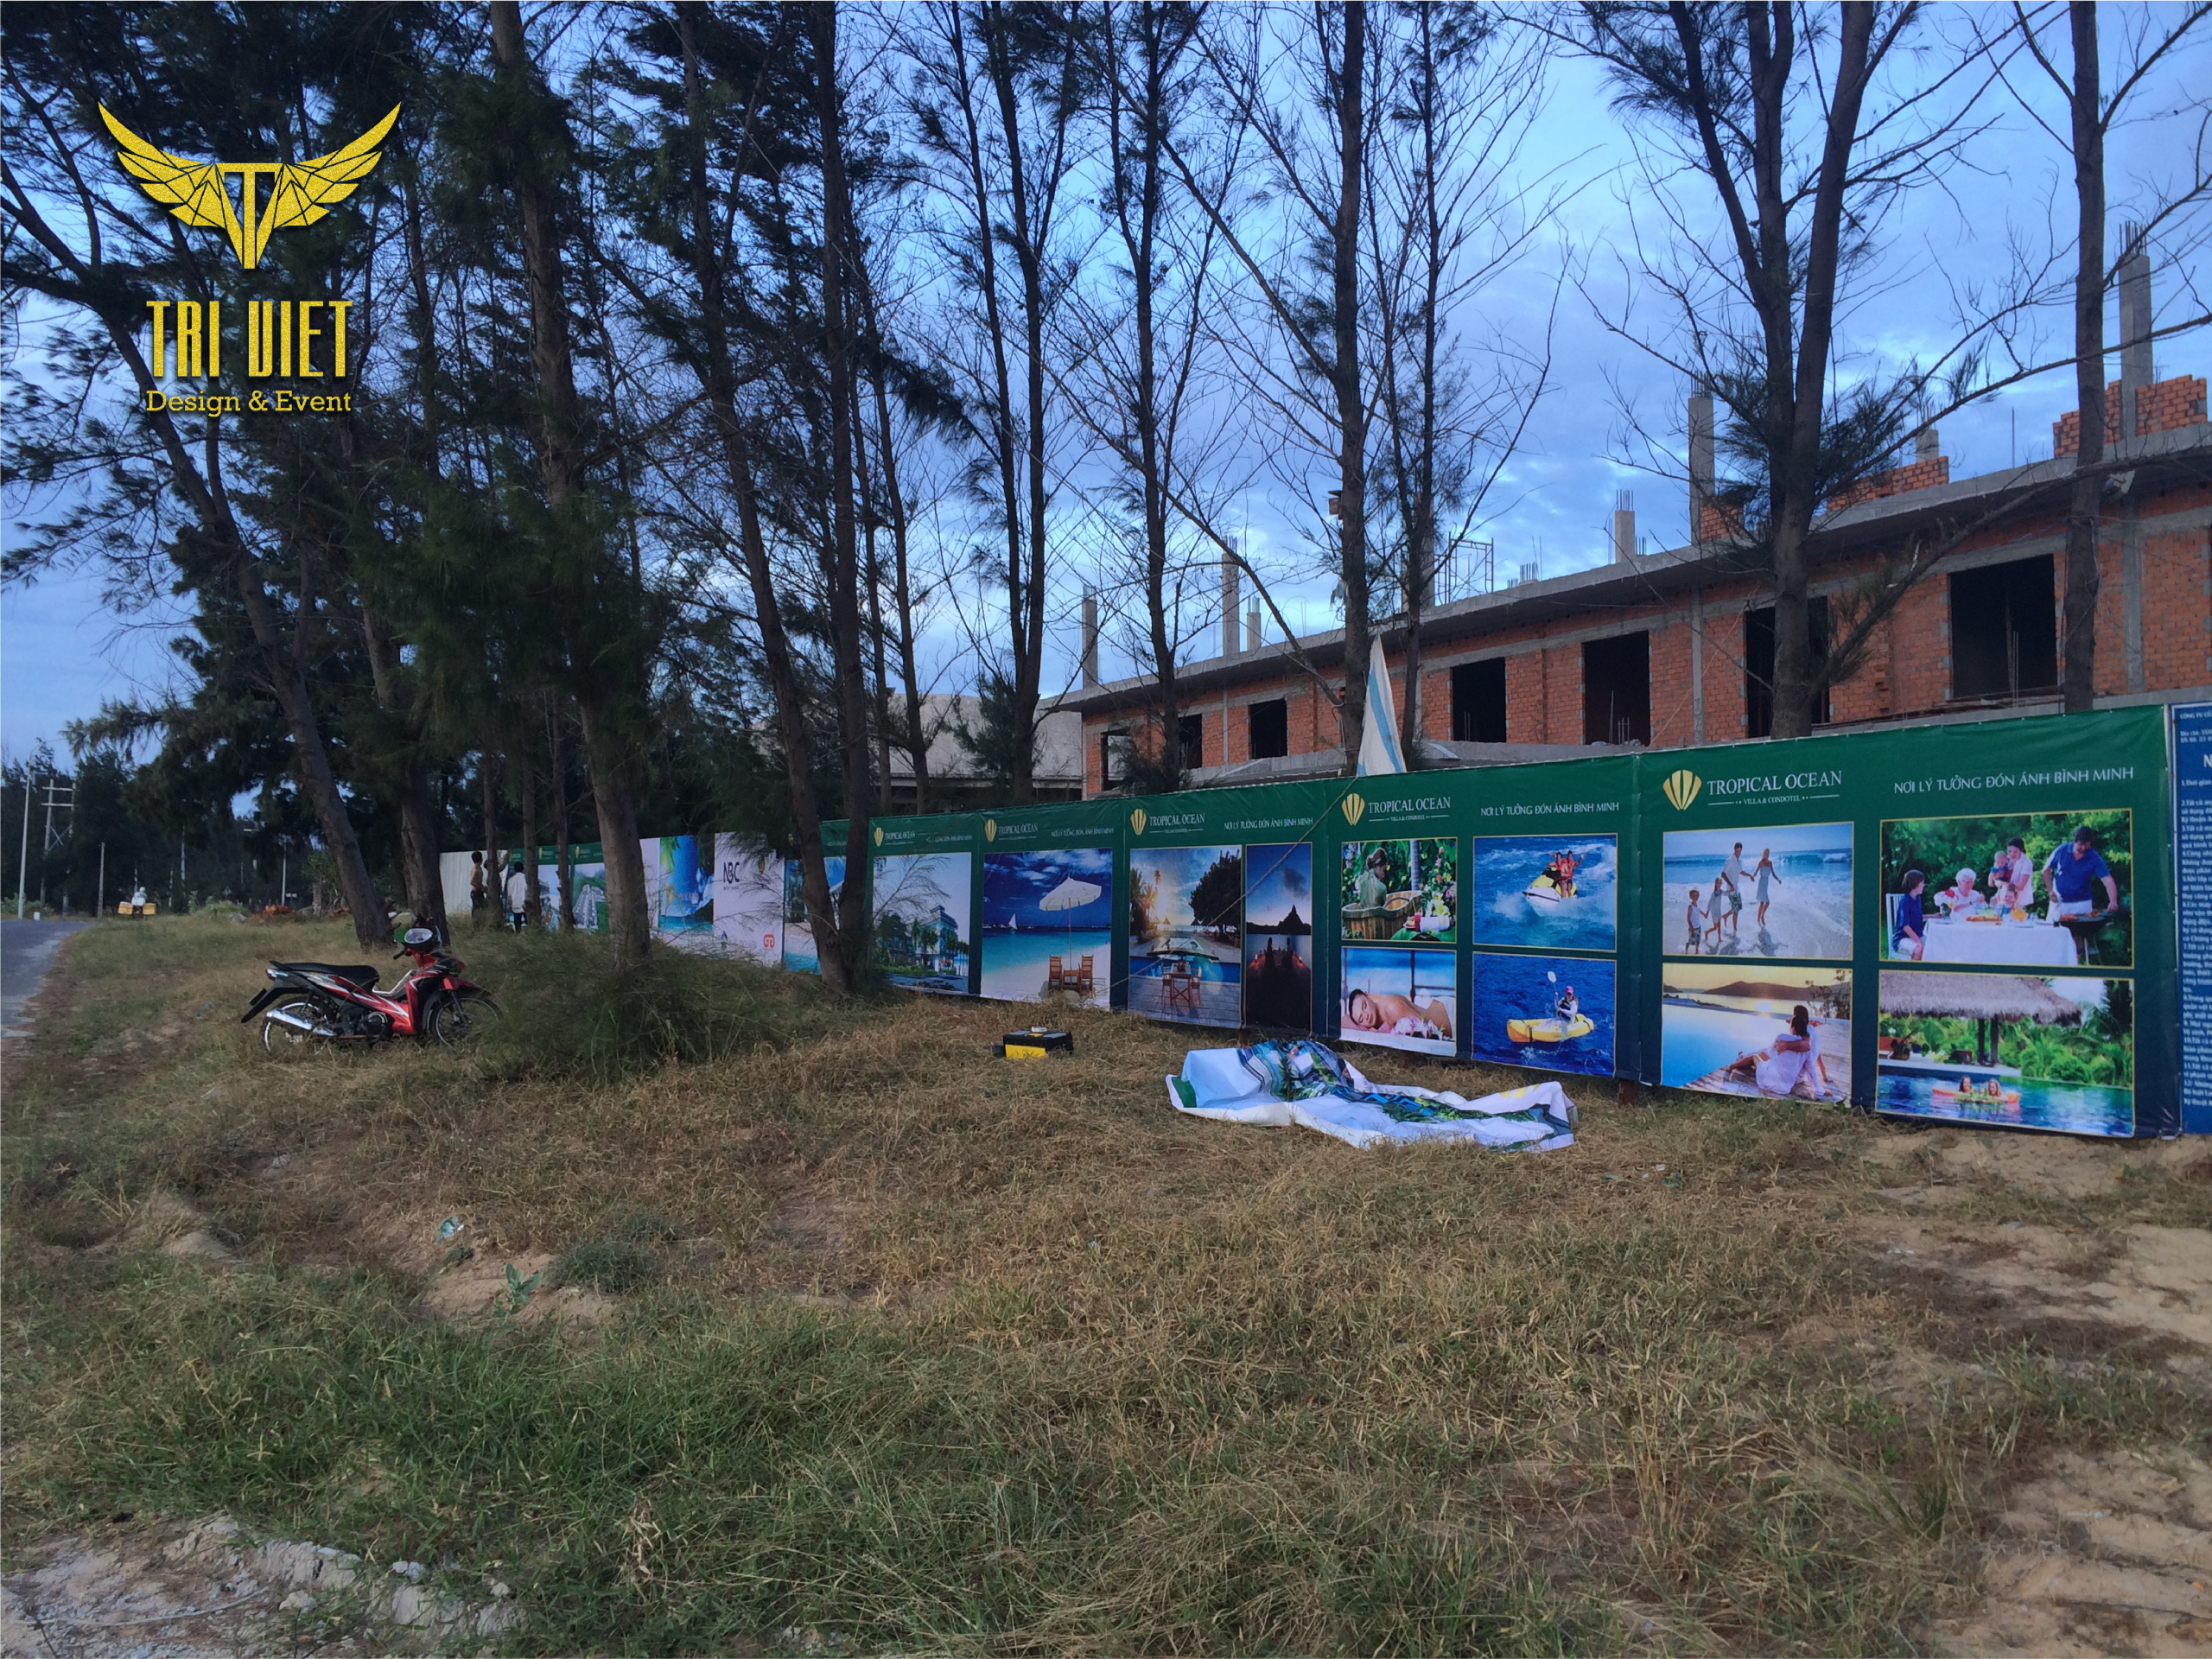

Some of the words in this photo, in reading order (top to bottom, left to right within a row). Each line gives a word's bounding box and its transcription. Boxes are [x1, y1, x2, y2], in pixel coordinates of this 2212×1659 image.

[1707, 776, 1782, 795] TROPICAL
[1785, 771, 1842, 790] OCEAN
[1919, 778, 1933, 791] LÝ
[1936, 774, 1981, 791] TƯỞNG
[1986, 773, 2015, 788] ĐÓN
[2018, 771, 2050, 785] ÁNH
[2054, 768, 2089, 784] BÌNH
[2093, 767, 2133, 781] MINH
[1368, 799, 1414, 813] TROPICAL
[1415, 797, 1451, 810] OCEAN
[1768, 795, 1801, 804] CONDOTEL
[1495, 805, 1504, 816] LÝ
[1506, 804, 1533, 815] TƯỞNG
[1535, 803, 1552, 814] ĐÓN
[1554, 803, 1572, 813] ÁNH
[1573, 802, 1594, 813] BÌNH
[1596, 802, 1619, 811] MINH
[1149, 815, 1181, 827] TROPICAL
[1182, 813, 1205, 824] OCEAN
[999, 825, 1020, 835] TROPICAL
[1020, 823, 1038, 833] OCEAN
